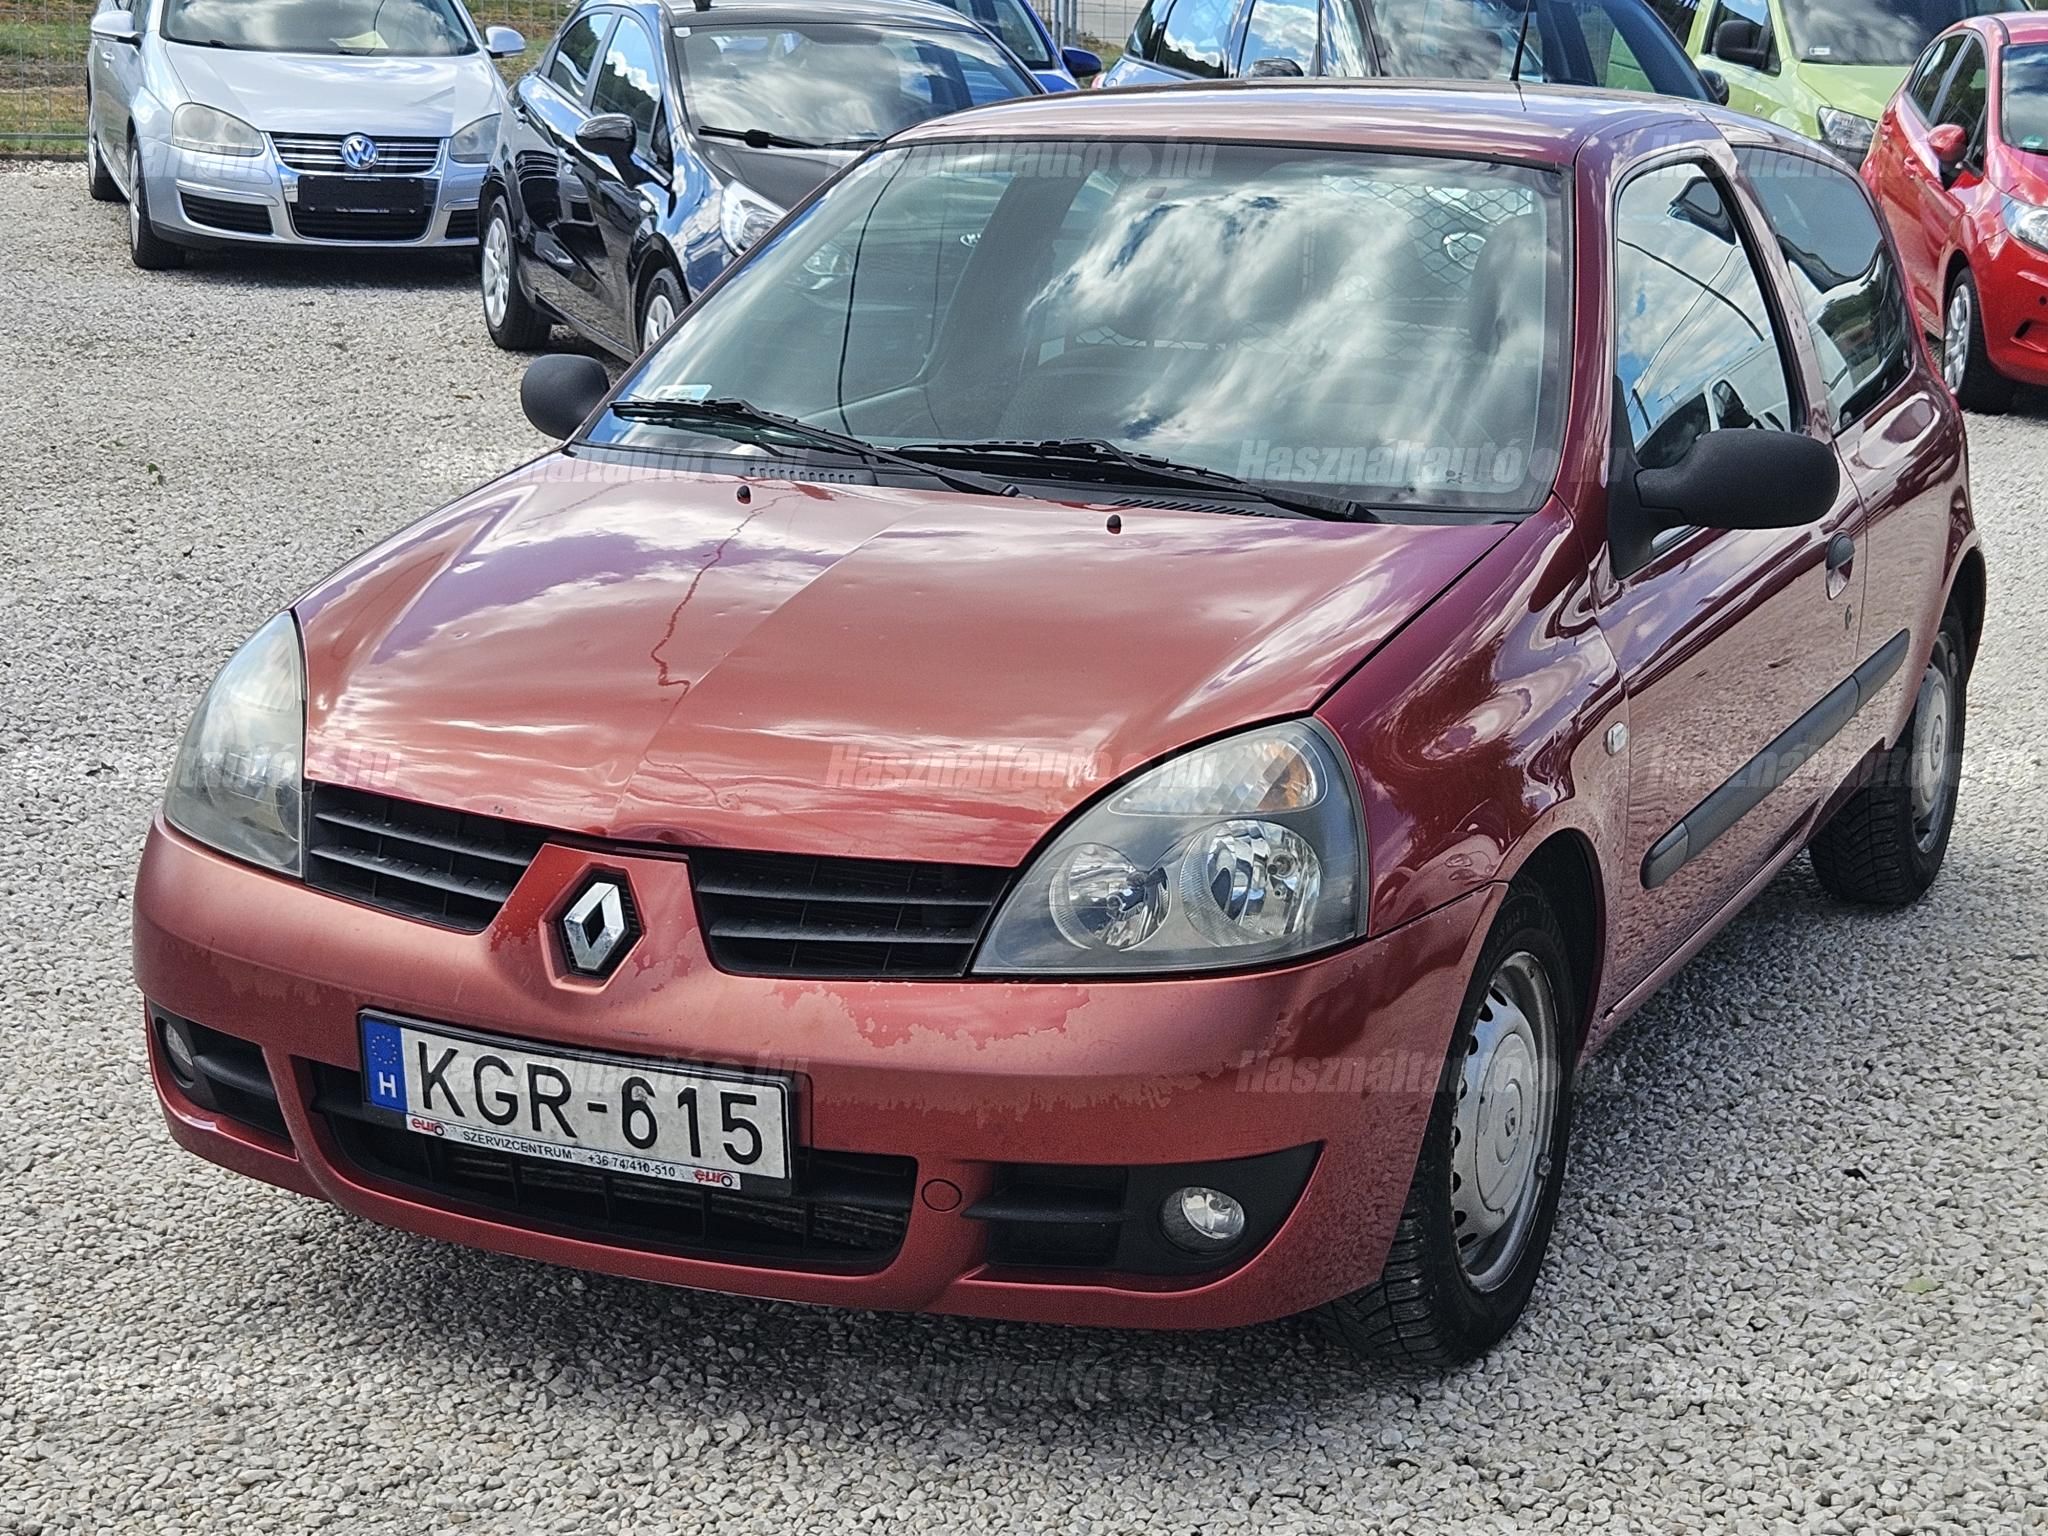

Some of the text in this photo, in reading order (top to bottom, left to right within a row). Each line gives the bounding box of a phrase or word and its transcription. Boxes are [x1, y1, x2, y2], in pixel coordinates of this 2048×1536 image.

[379, 1071, 397, 1098] H
[418, 1041, 764, 1166] KGR-615
[462, 1131, 573, 1160] SZERVIZCENTRUM
[588, 1153, 609, 1167] +36
